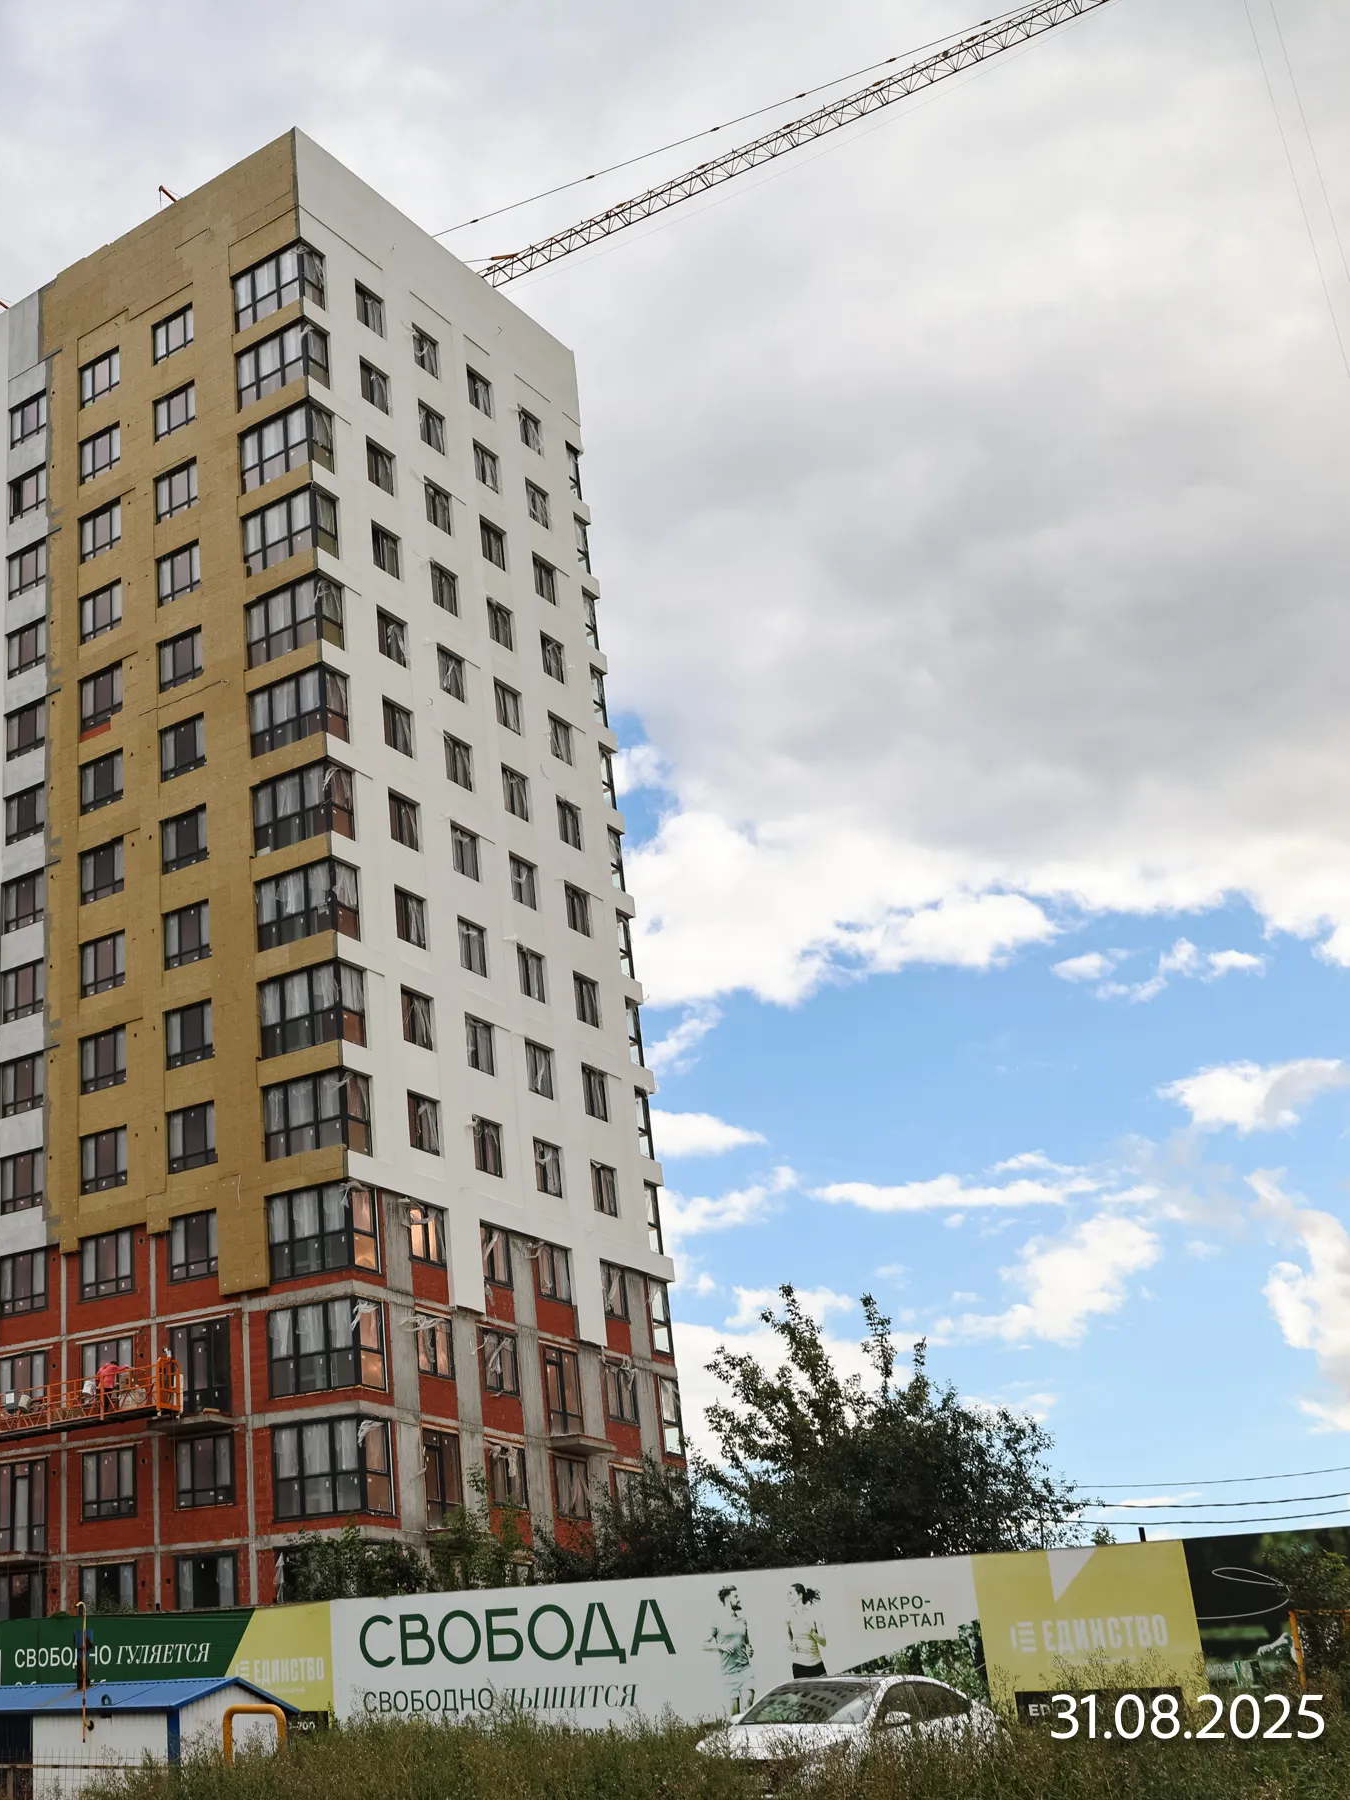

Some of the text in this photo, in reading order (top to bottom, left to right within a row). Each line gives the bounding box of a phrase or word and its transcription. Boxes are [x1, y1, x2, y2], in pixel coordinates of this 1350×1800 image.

[861, 1595, 931, 1612] МАКРО-
[359, 1599, 677, 1668] СВОБОДА
[863, 1612, 945, 1630] КВАРТАЛ
[1041, 1614, 1170, 1654] ЕДИНСТВО
[116, 1643, 211, 1665] ГУЛЯЕТСЯ
[253, 1656, 325, 1686] ЕДИНСТВО
[363, 1688, 494, 1714] СВОБОДНО
